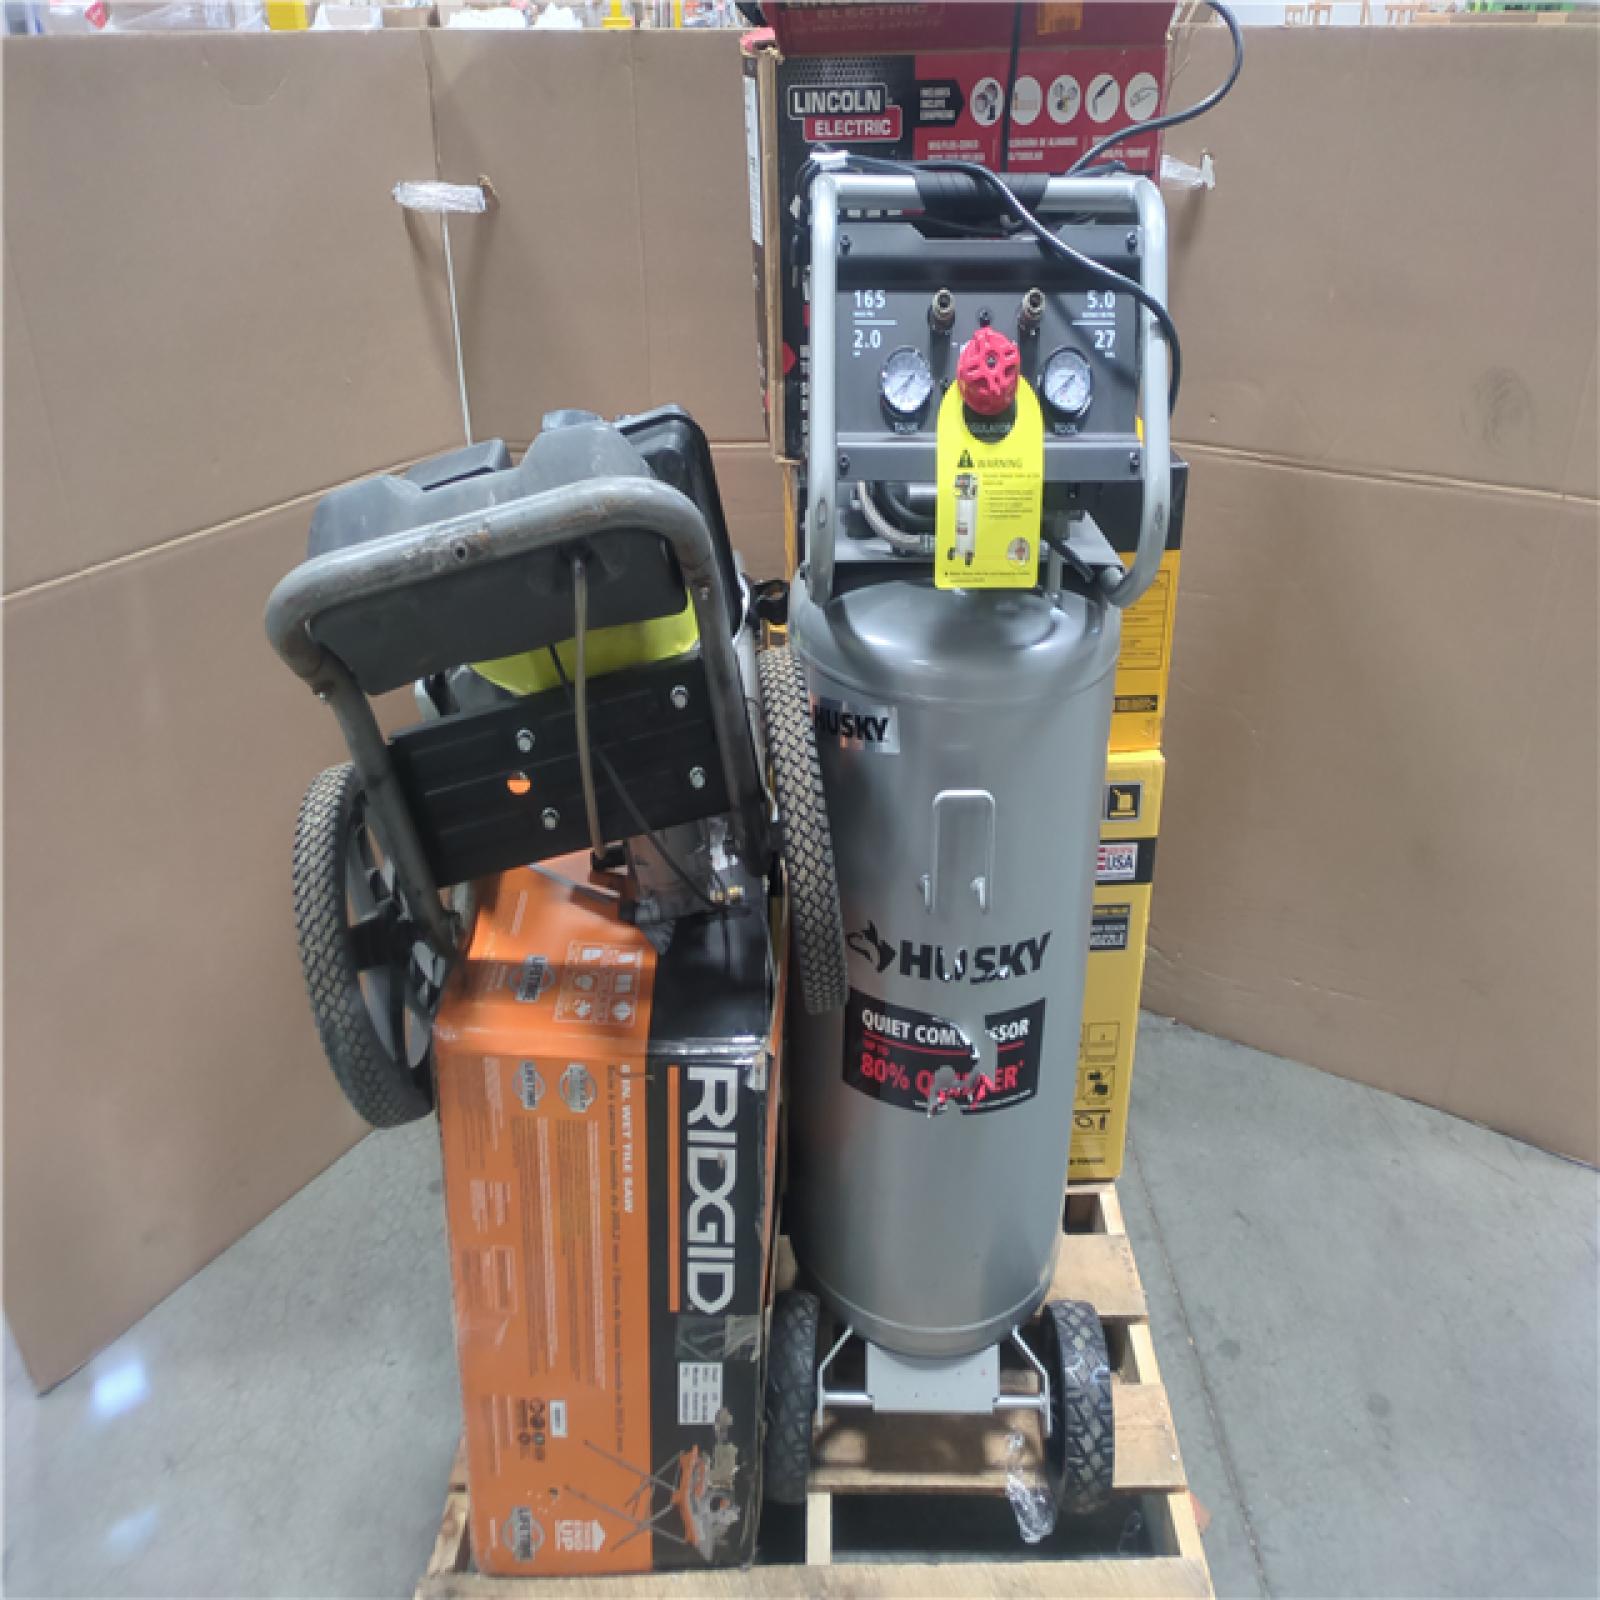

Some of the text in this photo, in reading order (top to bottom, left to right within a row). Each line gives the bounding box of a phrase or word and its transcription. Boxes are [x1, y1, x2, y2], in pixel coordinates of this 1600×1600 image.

[794, 90, 881, 113] LINCOLN
[814, 119, 891, 136] ELECTRIC
[854, 289, 886, 308] 165
[1087, 289, 1116, 308] 5.0
[854, 329, 881, 348] 2.0
[1094, 329, 1116, 349] 27
[900, 929, 1052, 985] HUSKY
[861, 1009, 911, 1040] QUIET
[861, 1052, 911, 1090] 80%
[687, 1067, 738, 1314] RIDGID
